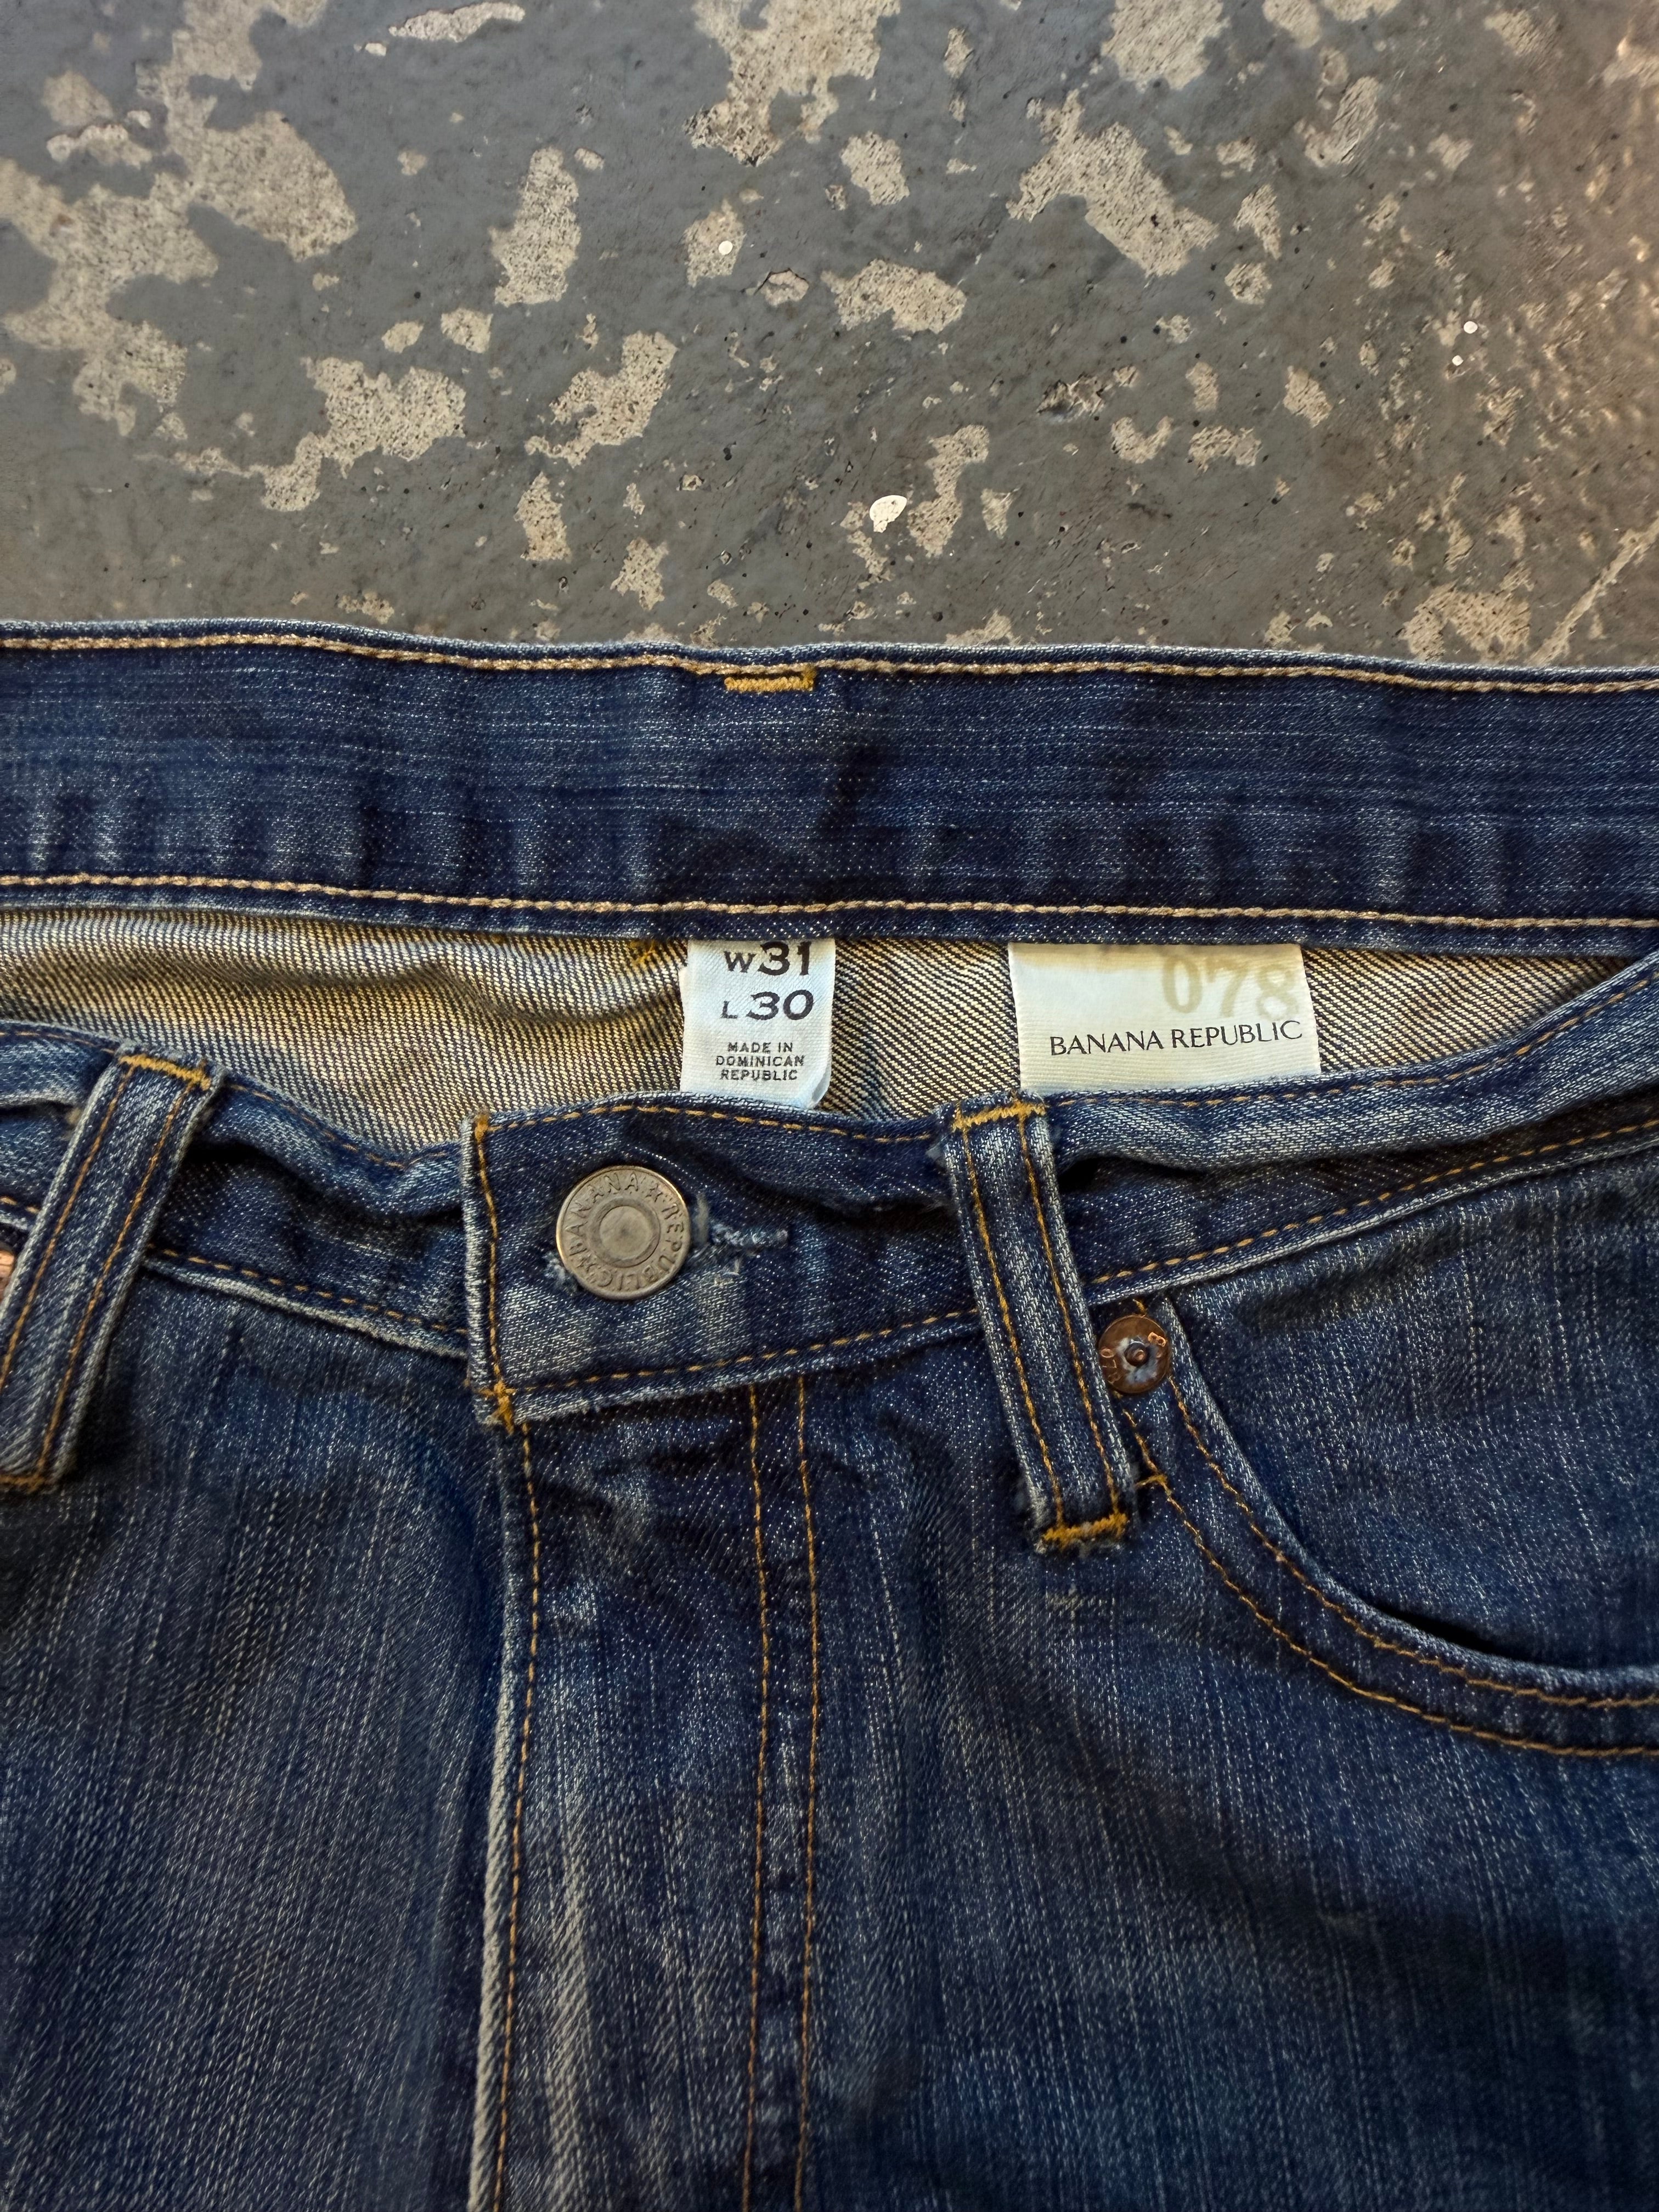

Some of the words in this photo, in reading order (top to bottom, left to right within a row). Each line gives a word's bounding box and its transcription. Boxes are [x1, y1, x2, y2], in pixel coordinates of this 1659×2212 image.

[723, 941, 812, 976] W31
[1161, 955, 1300, 1020] 078
[727, 1042, 771, 1053] MADE
[778, 1042, 793, 1052] IN
[1050, 1030, 1164, 1056] BANANA
[1171, 1020, 1303, 1048] REPUBLIC
[715, 1054, 805, 1067] DOMINICAN
[719, 1069, 798, 1081] REPUBLIC
